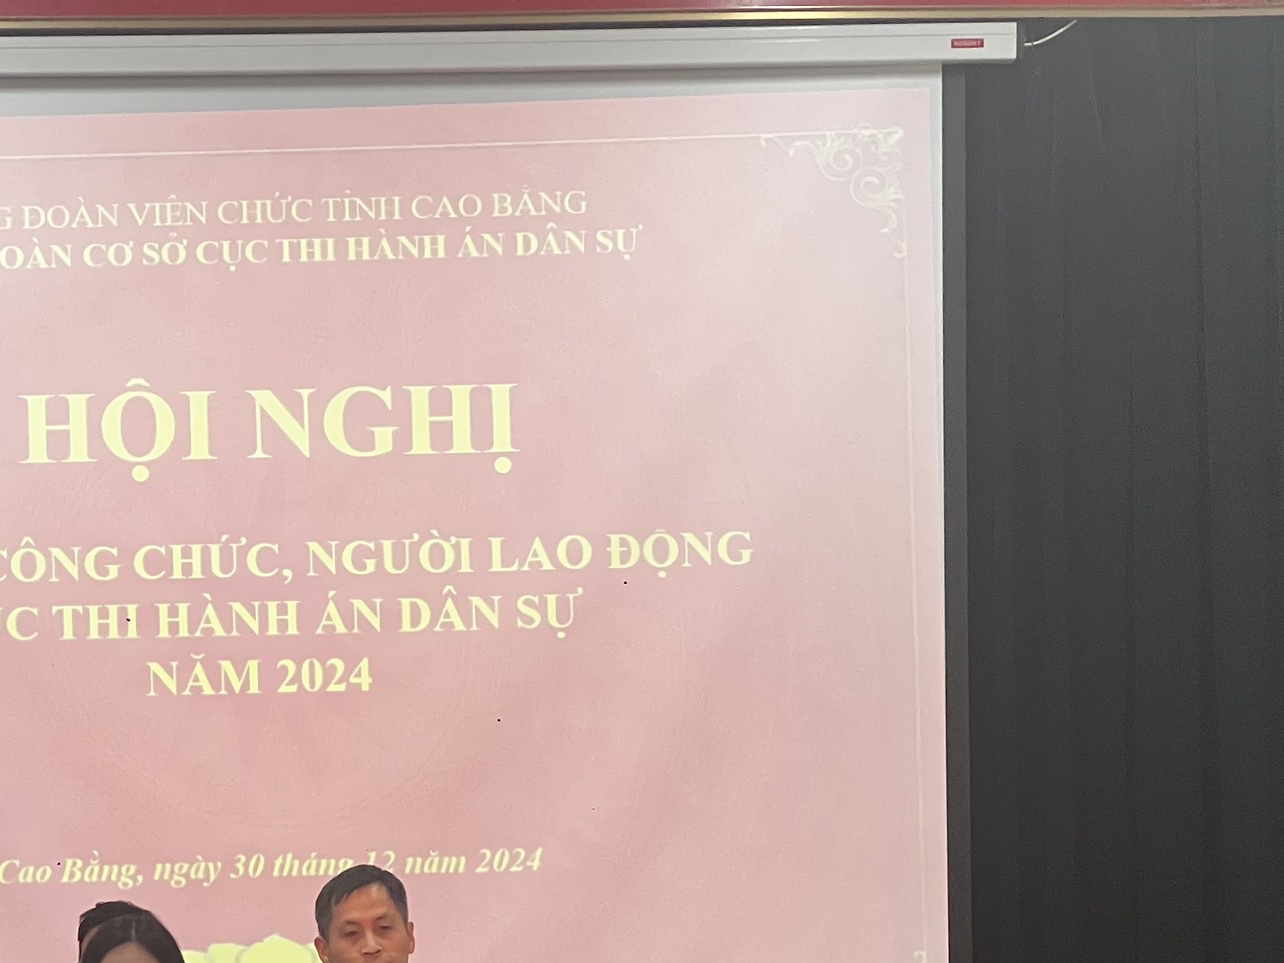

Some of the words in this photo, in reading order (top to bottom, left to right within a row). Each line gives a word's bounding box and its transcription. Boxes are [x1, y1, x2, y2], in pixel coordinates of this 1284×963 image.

[21, 197, 120, 230] ĐOÀN
[127, 194, 208, 226] VIÊN
[217, 192, 313, 224] CHỨC
[321, 189, 402, 221] TỈNH
[411, 194, 482, 219] CAO
[492, 184, 588, 217] BẰNG
[82, 240, 134, 267] CƠ
[142, 232, 188, 265] SỞ
[196, 240, 269, 272] CỤC
[275, 237, 337, 263] THI
[345, 228, 447, 261] HÀNH
[457, 226, 505, 258] ÁN
[515, 222, 587, 256] DÂN
[595, 224, 644, 260] SỰ
[21, 377, 217, 484] HỘI
[247, 382, 521, 475] NGHỊ
[132, 535, 294, 584] CHỨC,
[306, 529, 474, 577] NGƯỜI
[488, 535, 593, 572] LAO
[606, 529, 754, 578] ĐỘNG
[51, 602, 140, 642] THI
[155, 593, 300, 639] HÀNH
[315, 590, 383, 636] ÁN
[398, 585, 502, 634] DÂN
[515, 587, 584, 639] SỰ
[146, 653, 262, 697] NĂM
[276, 656, 374, 695] 2024
[60, 850, 144, 891] Bằng,
[153, 855, 222, 889] ngày
[230, 853, 265, 879] 30
[405, 850, 467, 874] năm
[475, 847, 543, 873] 2024
